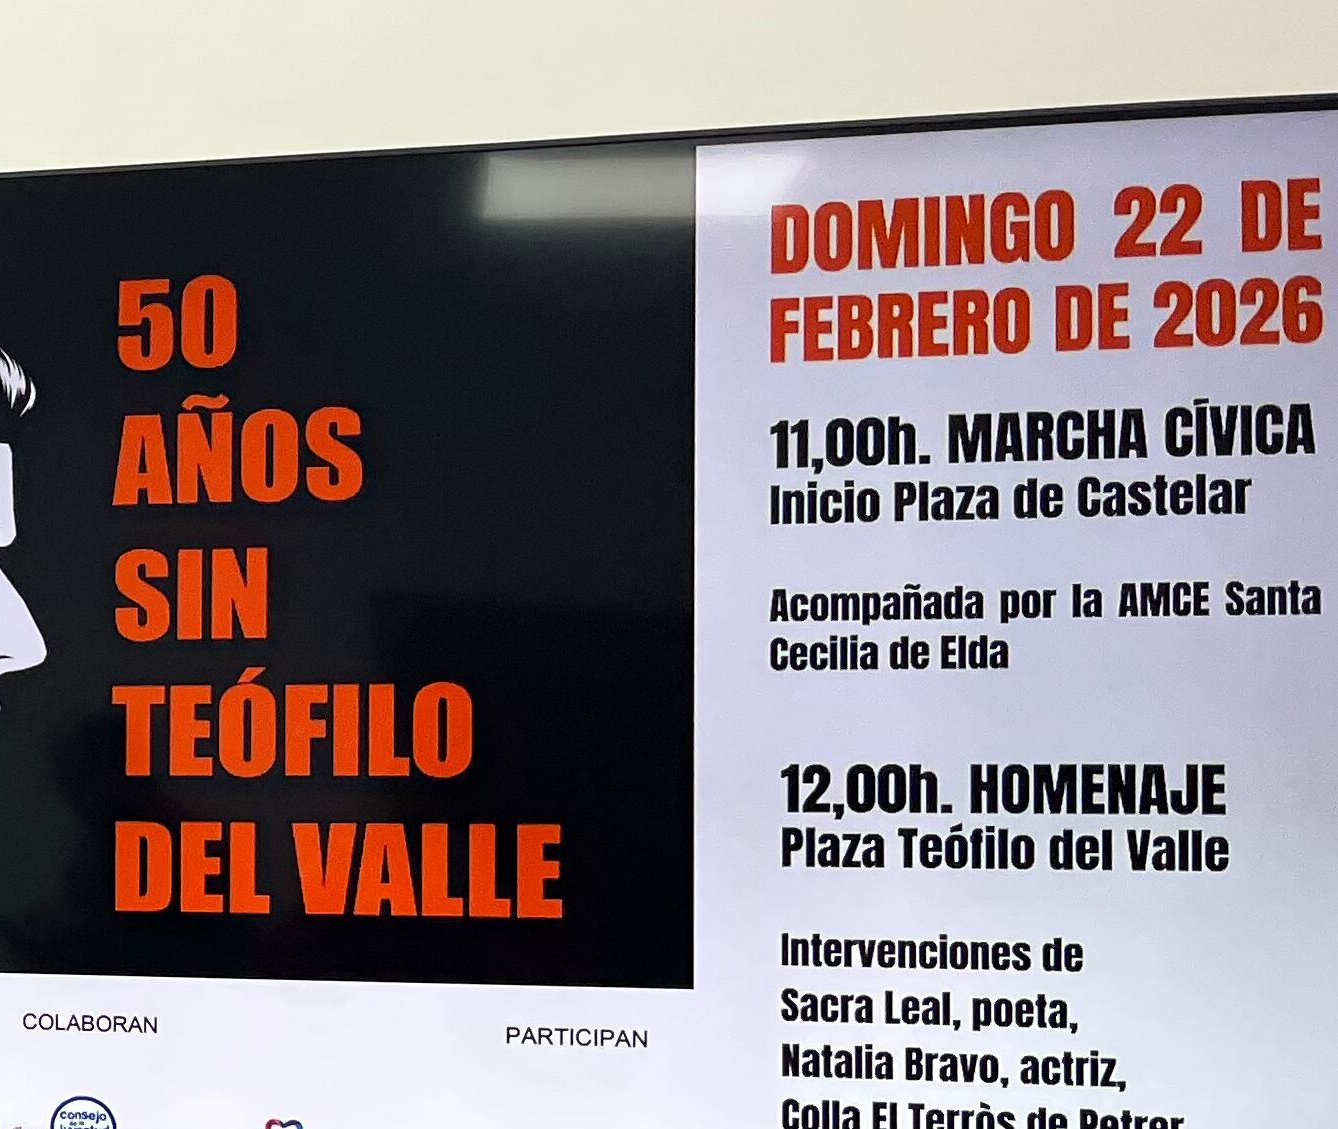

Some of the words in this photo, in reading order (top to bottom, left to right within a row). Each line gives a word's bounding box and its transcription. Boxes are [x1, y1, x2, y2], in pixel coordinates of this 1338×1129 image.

[770, 189, 1075, 274] DOMINGO
[1113, 183, 1204, 258] 22
[1241, 178, 1323, 252] DE
[117, 274, 238, 371] 50
[770, 287, 1031, 363] FEBRERO
[1055, 283, 1130, 352] DE
[1153, 275, 1323, 348] 2026
[112, 394, 364, 506] AÑOS
[769, 416, 931, 475] 11,00h.
[948, 408, 1148, 463] MARCHA
[1164, 398, 1316, 458] CÍVICA
[770, 479, 880, 525] Inicio
[894, 480, 999, 522] Plaza
[1013, 478, 1063, 518] de
[1077, 474, 1252, 517] Castelar
[115, 547, 269, 642] SIN
[770, 583, 984, 626] Acompañada
[1000, 587, 1056, 624] por
[1072, 583, 1103, 618] la
[1118, 581, 1210, 617] AMCE
[1225, 580, 1322, 616] Santa
[770, 636, 879, 671] Cecilia
[889, 636, 930, 670] de
[941, 634, 1009, 669] Elda
[112, 667, 473, 779] TEÓFILO
[780, 763, 953, 820] 12,00h.
[970, 764, 1227, 815] HOMENAJE
[115, 821, 271, 914] DEL
[292, 822, 563, 919] VALLE
[781, 827, 885, 868] Plaza
[898, 822, 1036, 870] Teófilo
[1049, 829, 1112, 871] del
[1127, 829, 1229, 872] Valle
[780, 932, 1031, 971] Intervenciones
[1042, 937, 1084, 972] de
[22, 1012, 158, 1035] COLABORAN
[780, 988, 874, 1023] Sacra
[885, 990, 961, 1031] Leal,
[972, 994, 1079, 1033] poeta,
[505, 1025, 649, 1050] PARTICIPAN
[781, 1043, 894, 1080] Natalia
[905, 1047, 1010, 1088] Bravo,
[1020, 1050, 1127, 1092] actriz,
[59, 1110, 107, 1124] consejo
